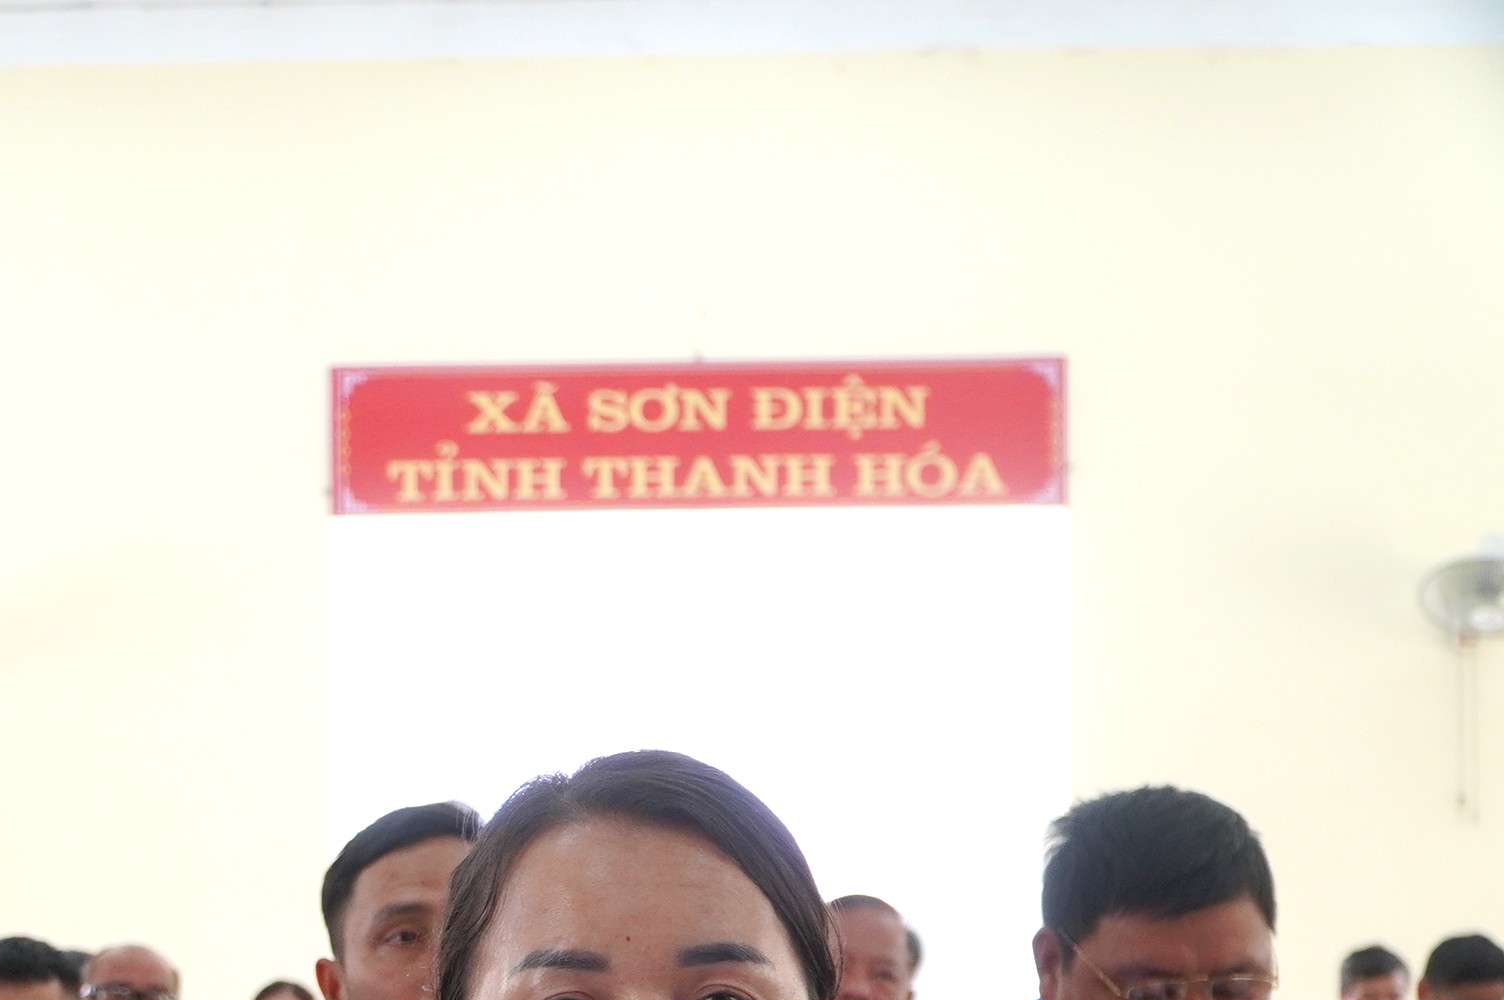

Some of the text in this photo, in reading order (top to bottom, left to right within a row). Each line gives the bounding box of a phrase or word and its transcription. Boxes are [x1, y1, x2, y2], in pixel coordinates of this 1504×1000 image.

[466, 373, 930, 440] XÃ SƠN ĐIỆN
[387, 439, 1008, 502] TỈNH THANH HÓA
